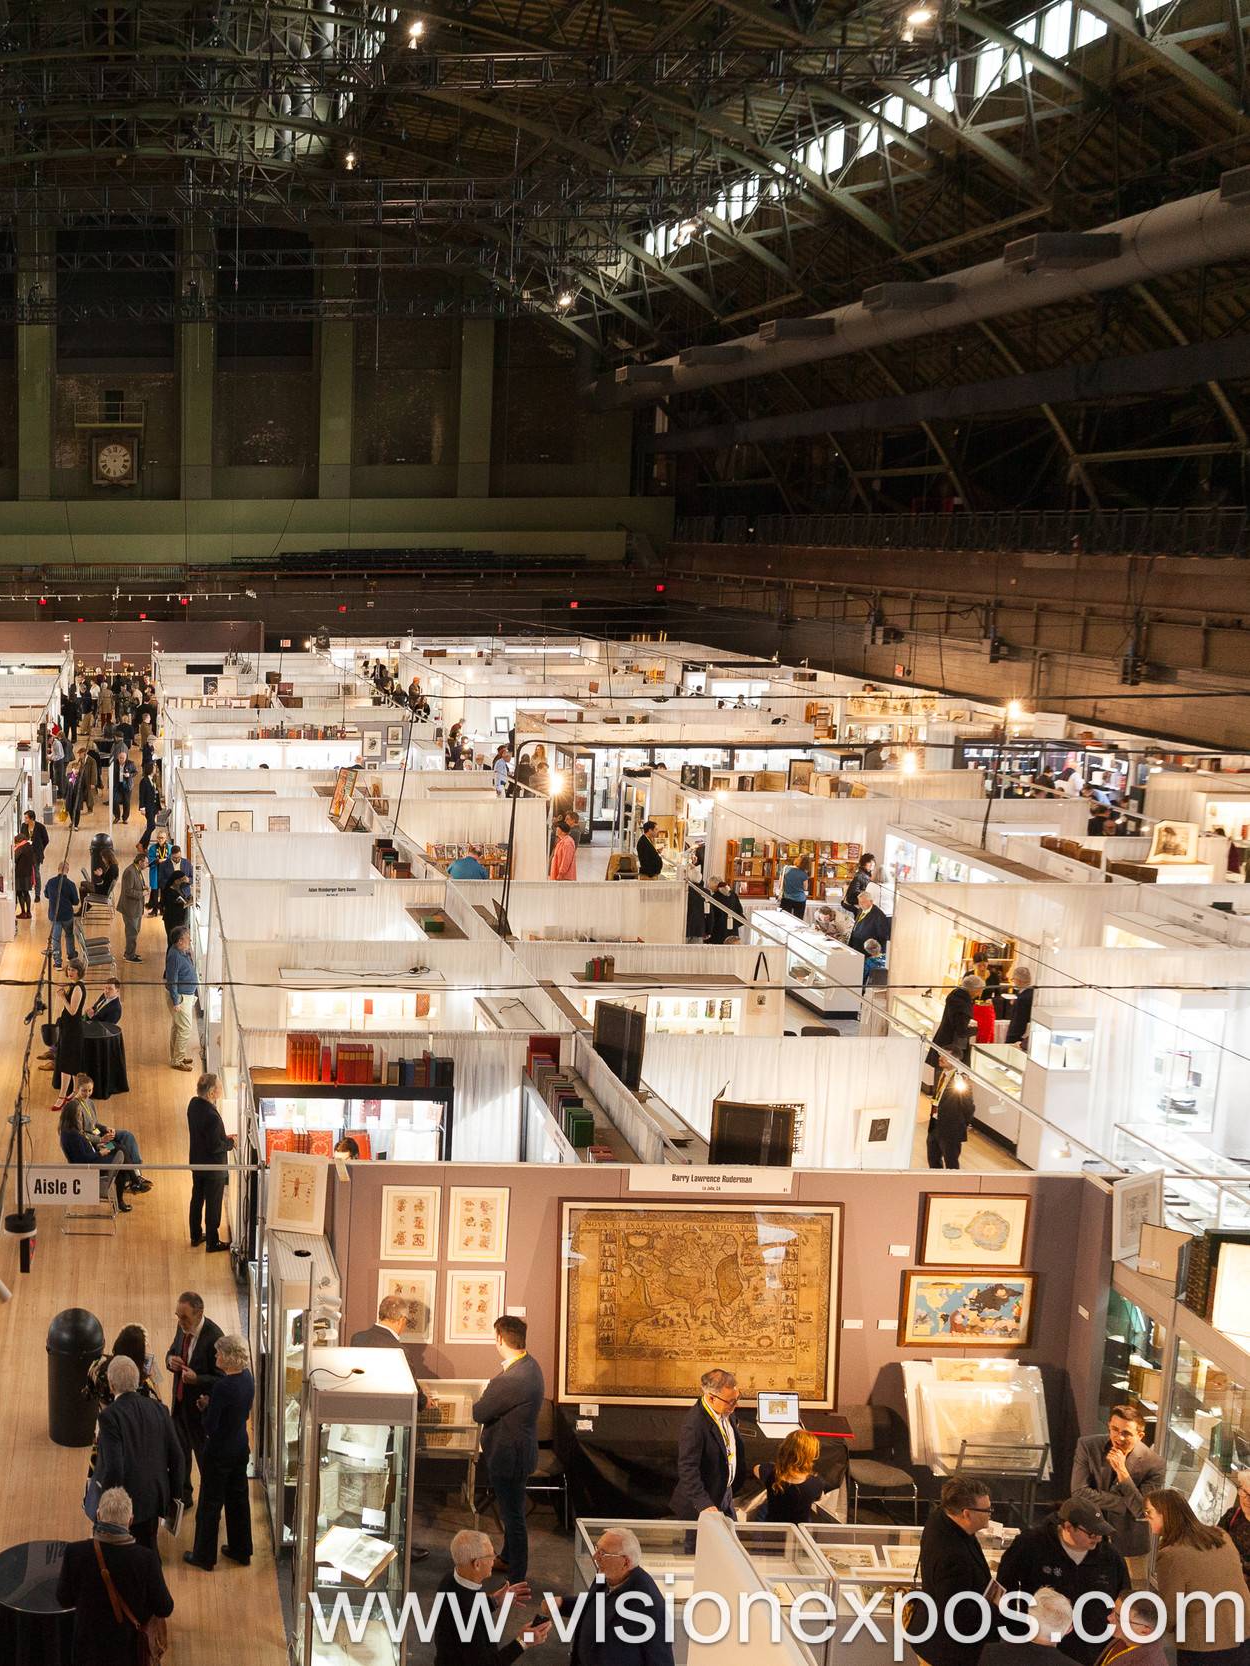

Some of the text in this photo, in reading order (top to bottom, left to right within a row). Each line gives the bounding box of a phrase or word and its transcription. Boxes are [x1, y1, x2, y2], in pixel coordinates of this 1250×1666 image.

[671, 1174, 752, 1183] Barry Lawrence Ruderman
[34, 1179, 81, 1195] Aisle C
